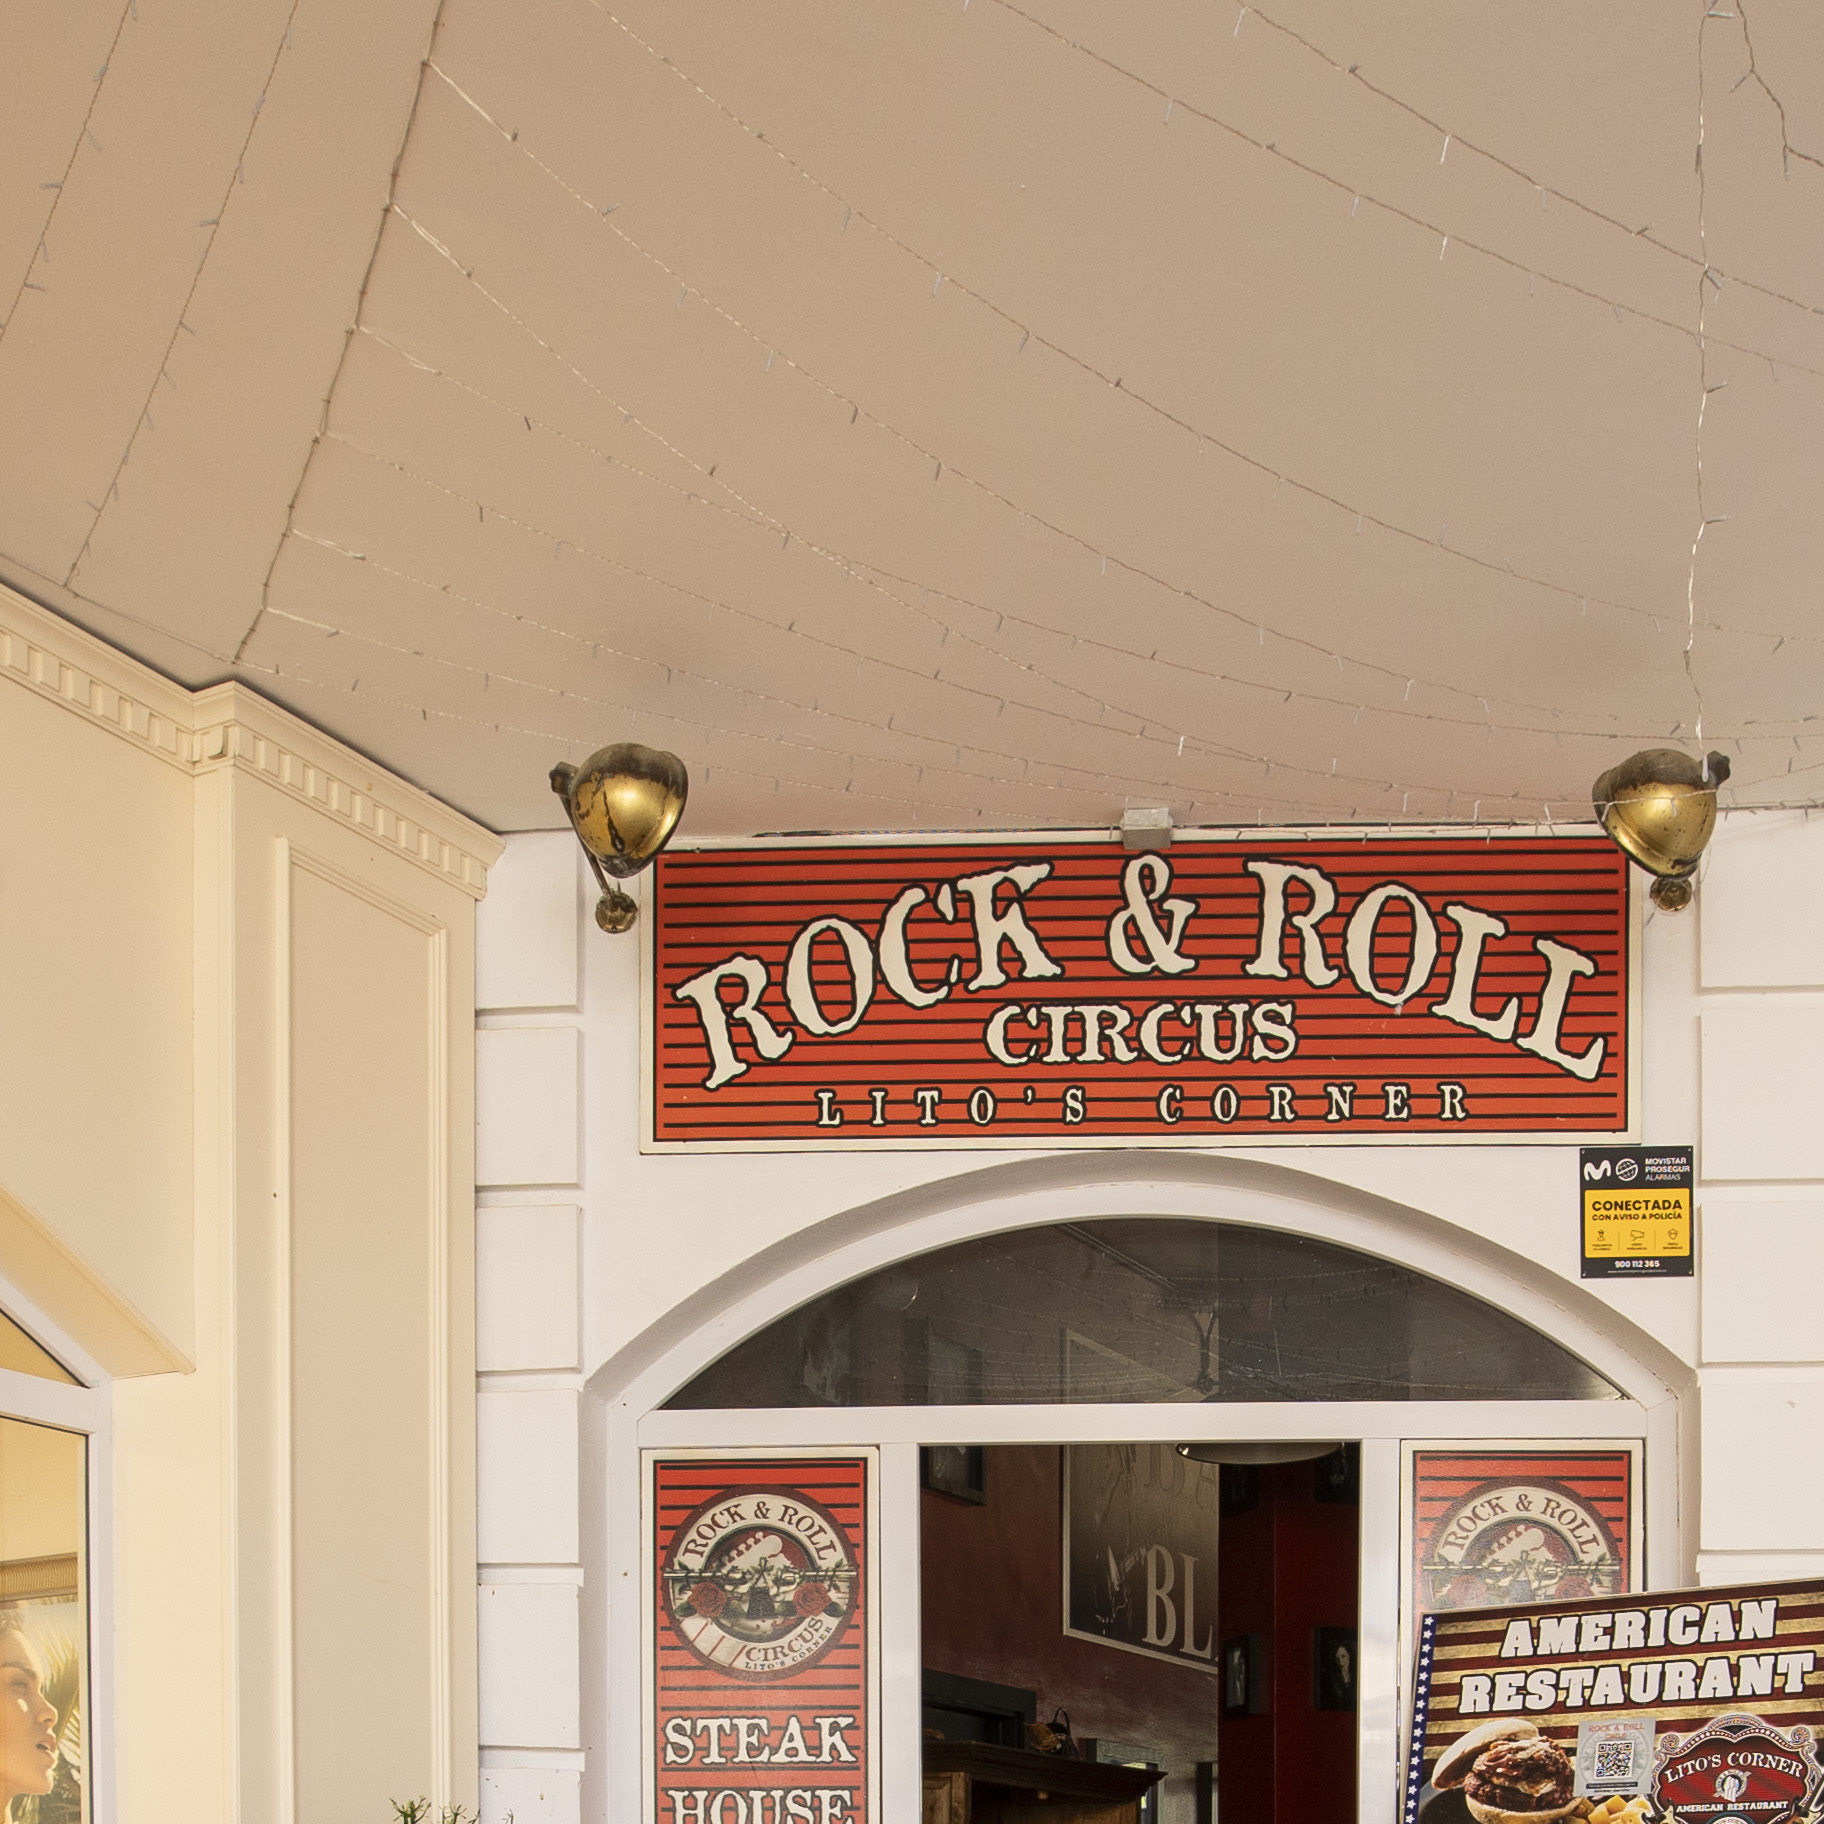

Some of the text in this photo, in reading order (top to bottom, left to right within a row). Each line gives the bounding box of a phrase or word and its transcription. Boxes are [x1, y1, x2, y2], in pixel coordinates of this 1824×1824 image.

[675, 852, 1611, 1090] ROCK & ROLL
[985, 1002, 1297, 1065] CIRCUS
[817, 1081, 1470, 1128] LITO'S CORNER
[1645, 1157, 1687, 1165] MOVISTAR
[1645, 1165, 1690, 1173] PROSEGUR
[1592, 1200, 1682, 1211] CONECTADA
[1649, 1211, 1682, 1219] POLICÍA
[1632, 1260, 1643, 1268] 112
[683, 1501, 837, 1560] ROCK & ROLL
[1441, 1493, 1601, 1555] ROCK & ROLL
[1142, 1543, 1218, 1662] BL
[745, 1617, 823, 1662] CIRCUS
[745, 1626, 833, 1670] LITO'S CORNER
[1500, 1599, 1779, 1659] AMERICAN
[1459, 1652, 1816, 1714] RESTAURANT
[664, 1717, 856, 1764] STEAK
[1664, 1754, 1722, 1784] LITO'S
[1727, 1752, 1804, 1778] CORNER
[1676, 1801, 1789, 1813] AMERICAN RESTAURANT
